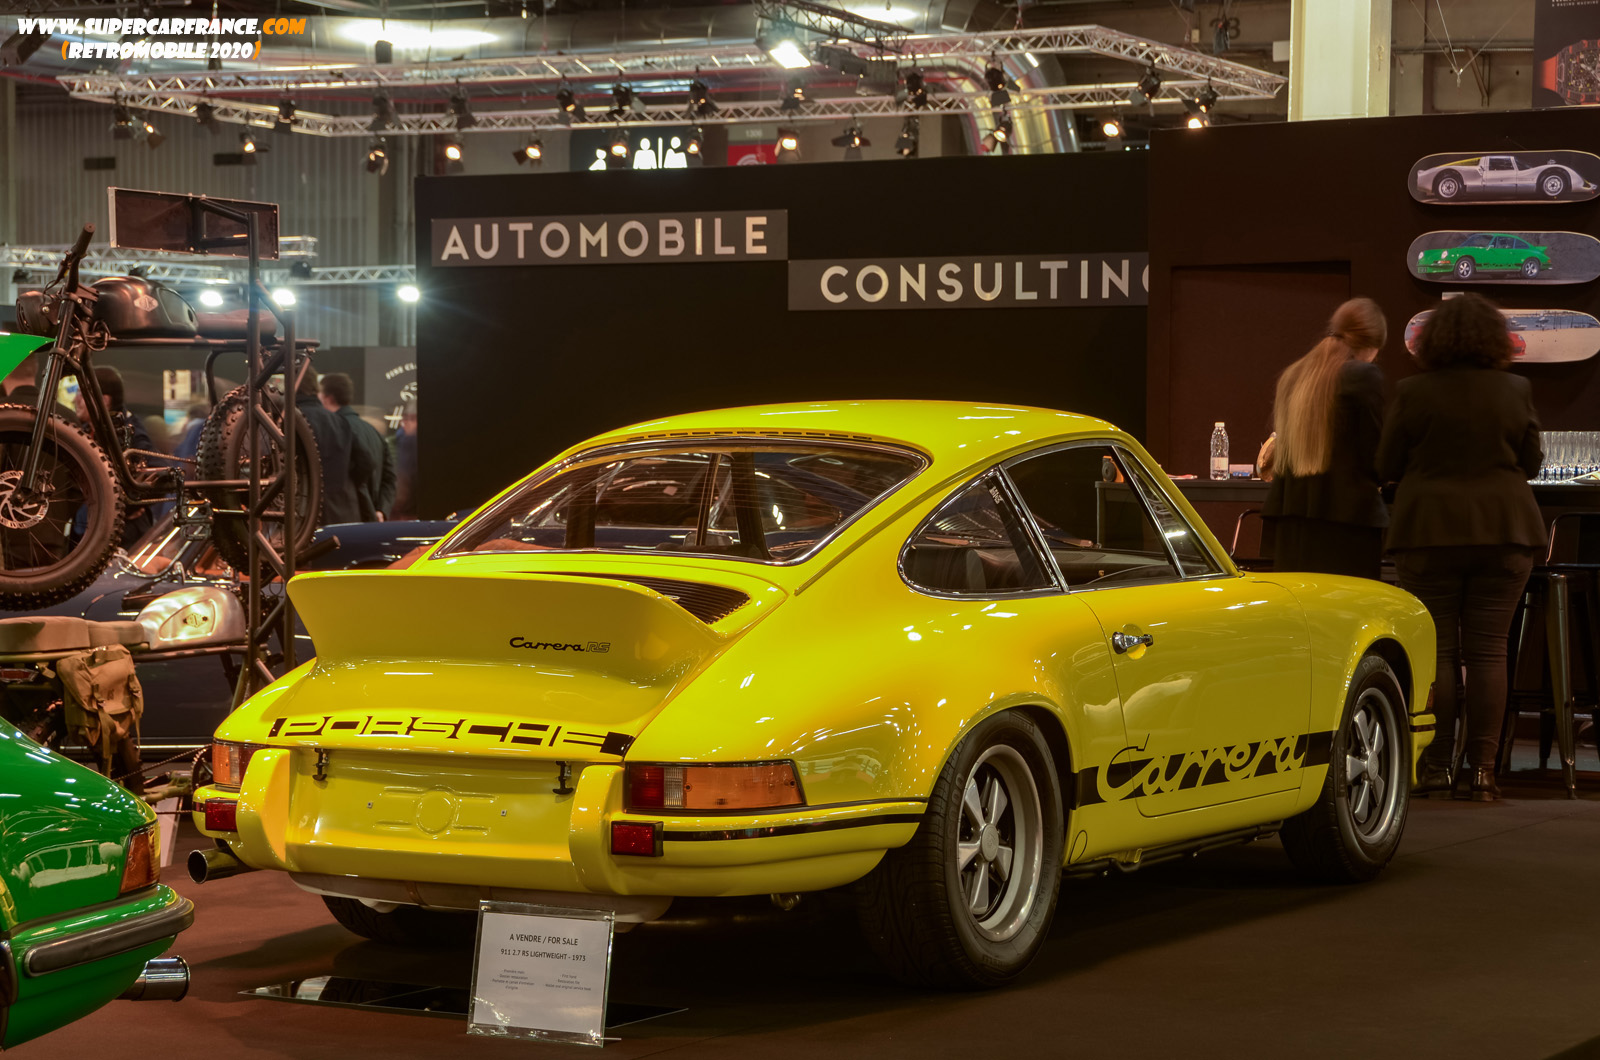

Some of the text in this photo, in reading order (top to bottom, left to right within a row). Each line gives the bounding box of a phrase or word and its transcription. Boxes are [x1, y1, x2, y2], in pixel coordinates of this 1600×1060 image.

[441, 215, 768, 261] AUTOMOBILE
[820, 259, 1150, 304] CONSULTIN
[509, 636, 611, 654] Carrera RS
[280, 715, 606, 751] PORSCHE
[1096, 733, 1306, 801] Carrera
[516, 934, 542, 943] VENDRE
[562, 938, 578, 946] SALE
[530, 951, 567, 960] LIGHTWEIGHT
